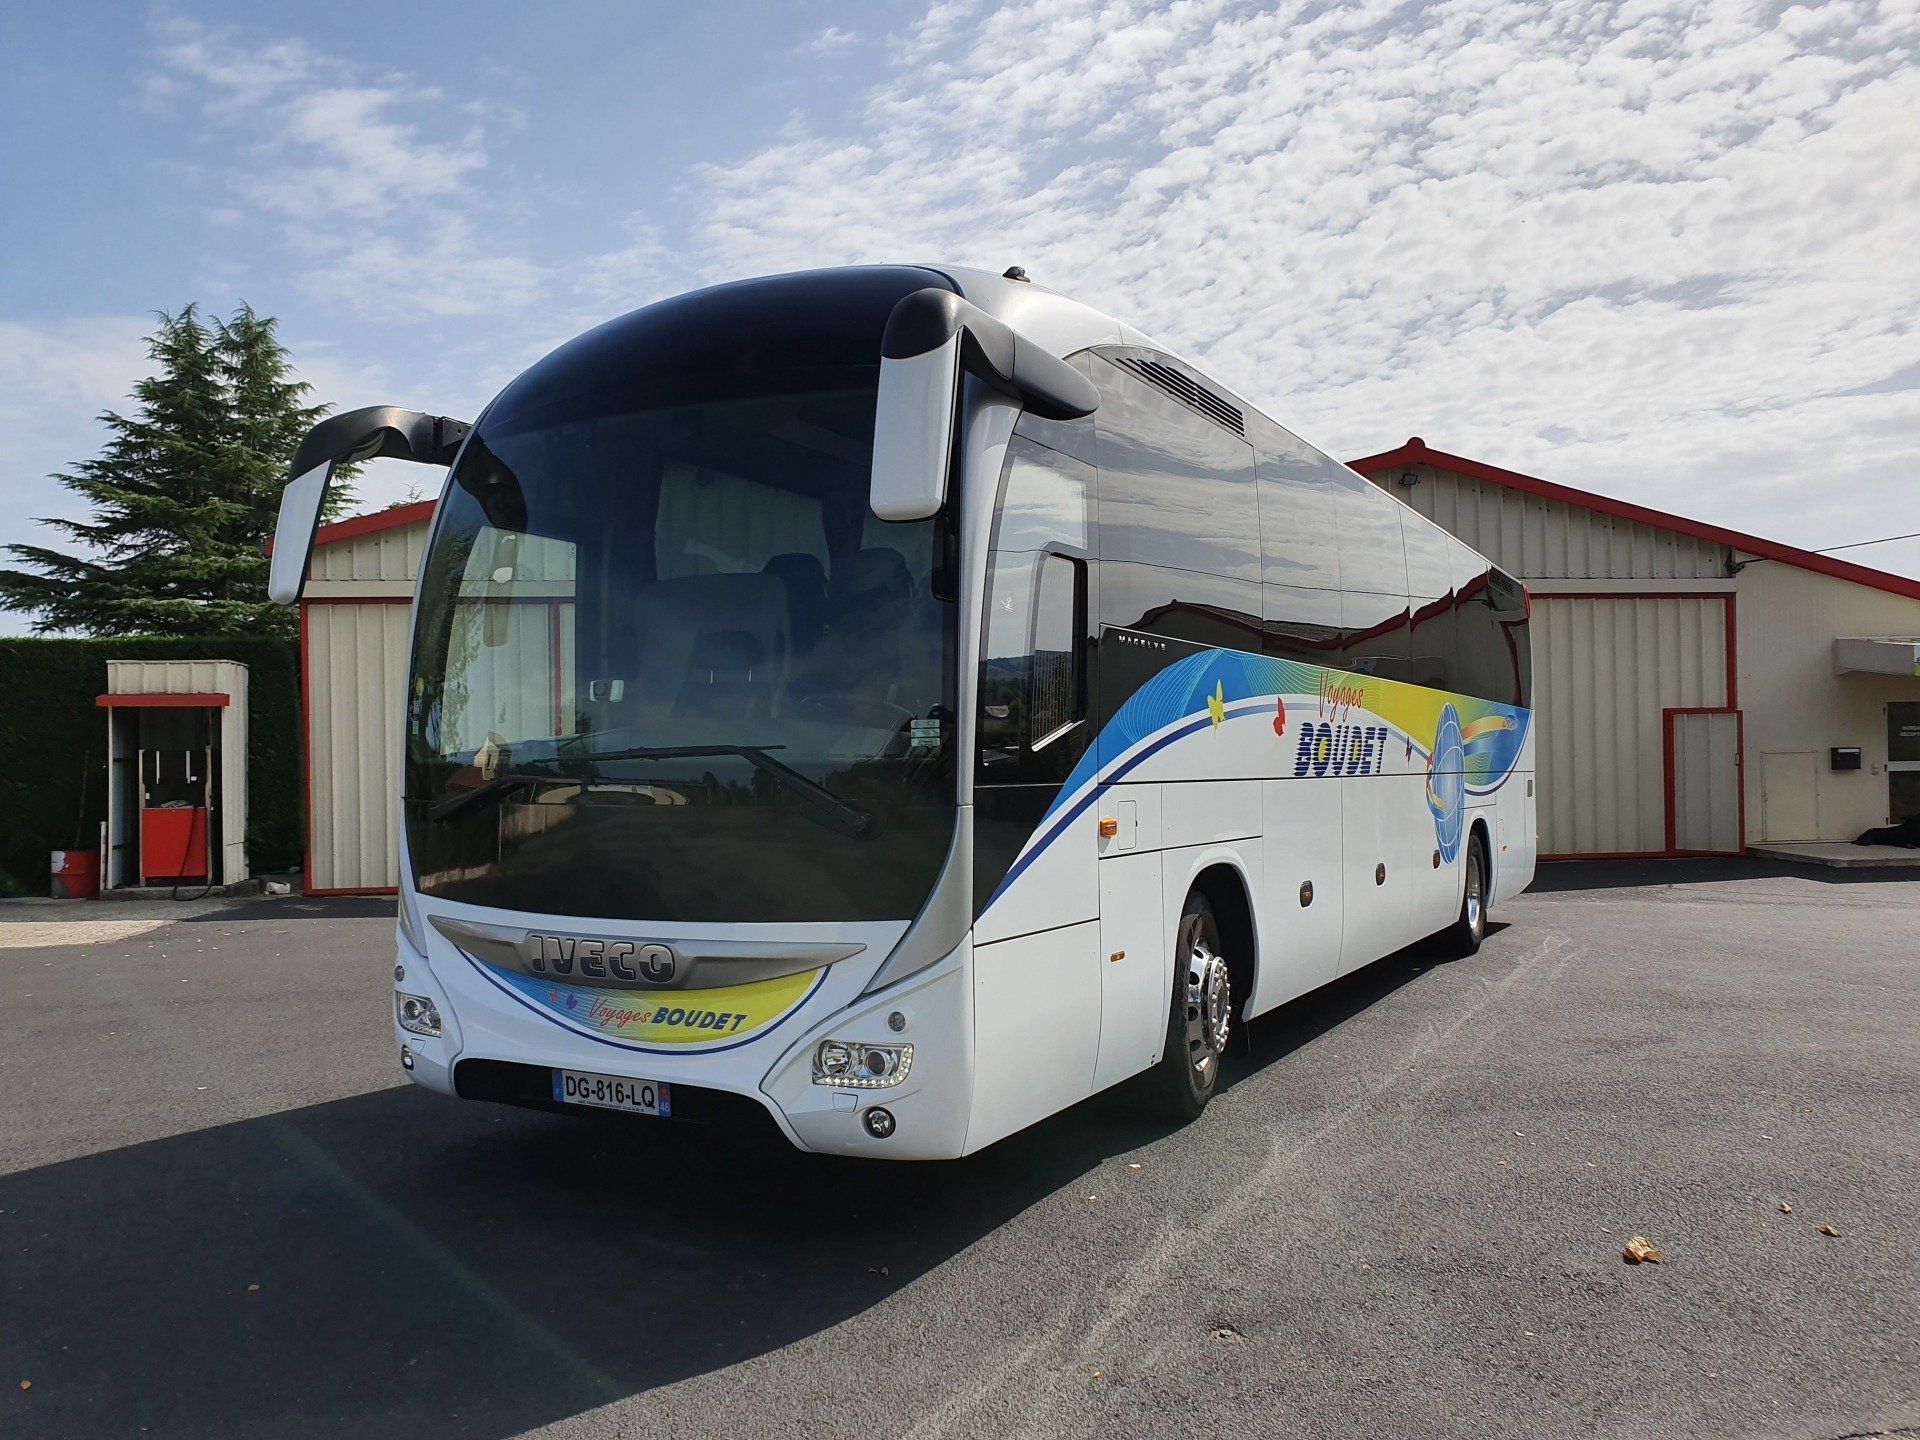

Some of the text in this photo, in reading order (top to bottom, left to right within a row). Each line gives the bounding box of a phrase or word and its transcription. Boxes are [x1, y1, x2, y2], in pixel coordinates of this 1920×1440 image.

[1319, 669, 1364, 724] Voyages
[1292, 722, 1389, 777] BOUDET
[529, 934, 675, 983] IVECO
[589, 996, 747, 1031] Voyages BOUDET
[565, 1075, 656, 1110] DG-816-LQ
